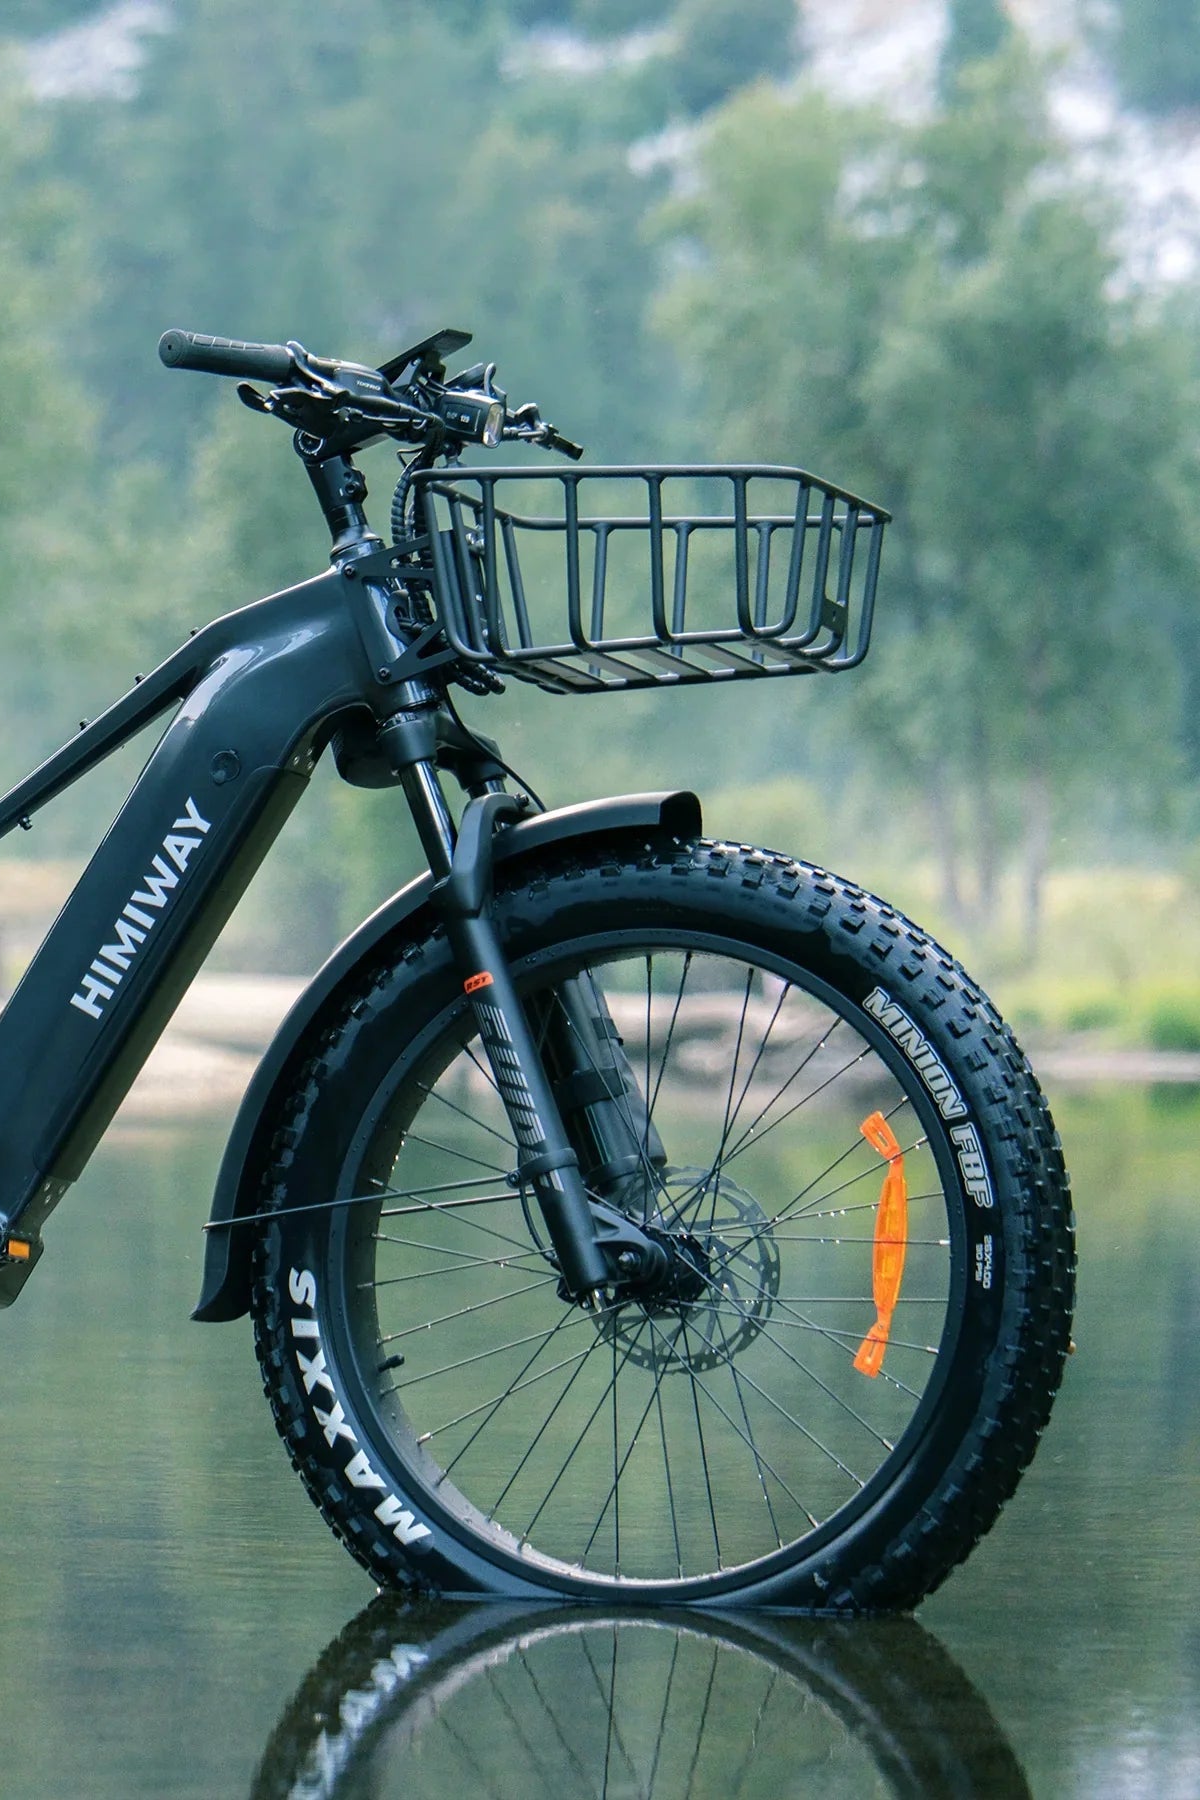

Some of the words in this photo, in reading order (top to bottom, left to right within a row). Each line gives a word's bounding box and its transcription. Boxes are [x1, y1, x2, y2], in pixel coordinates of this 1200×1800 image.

[69, 796, 212, 1020] HIMIWAY
[466, 975, 489, 992] RST
[862, 986, 968, 1121] MINION
[950, 1122, 994, 1208] FBF
[975, 1261, 983, 1281] PSI
[288, 1266, 433, 1546] MAXXIS
